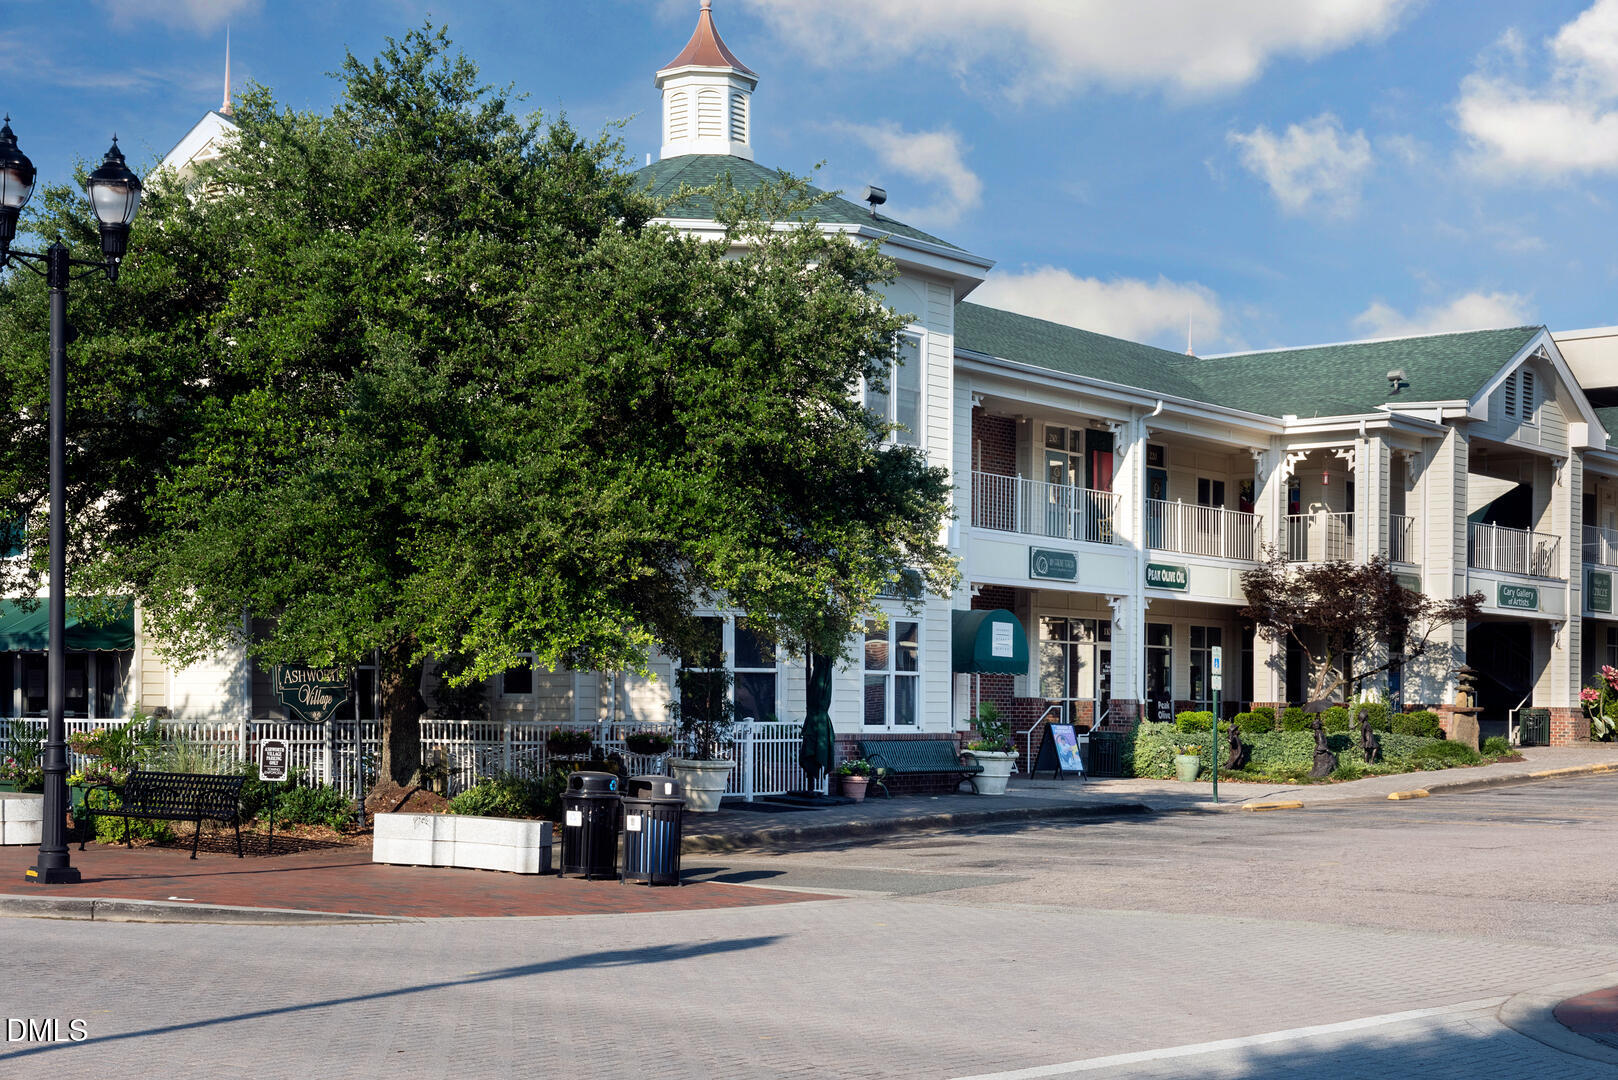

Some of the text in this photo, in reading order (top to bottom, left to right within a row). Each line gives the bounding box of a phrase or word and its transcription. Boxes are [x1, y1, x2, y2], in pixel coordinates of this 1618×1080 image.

[1161, 569, 1176, 583] OLIVE
[1176, 571, 1186, 584] OIL
[1503, 587, 1535, 600] Cary Gallery
[1513, 599, 1530, 607] Artists
[284, 669, 344, 684] ASHWOT
[298, 684, 333, 710] Village
